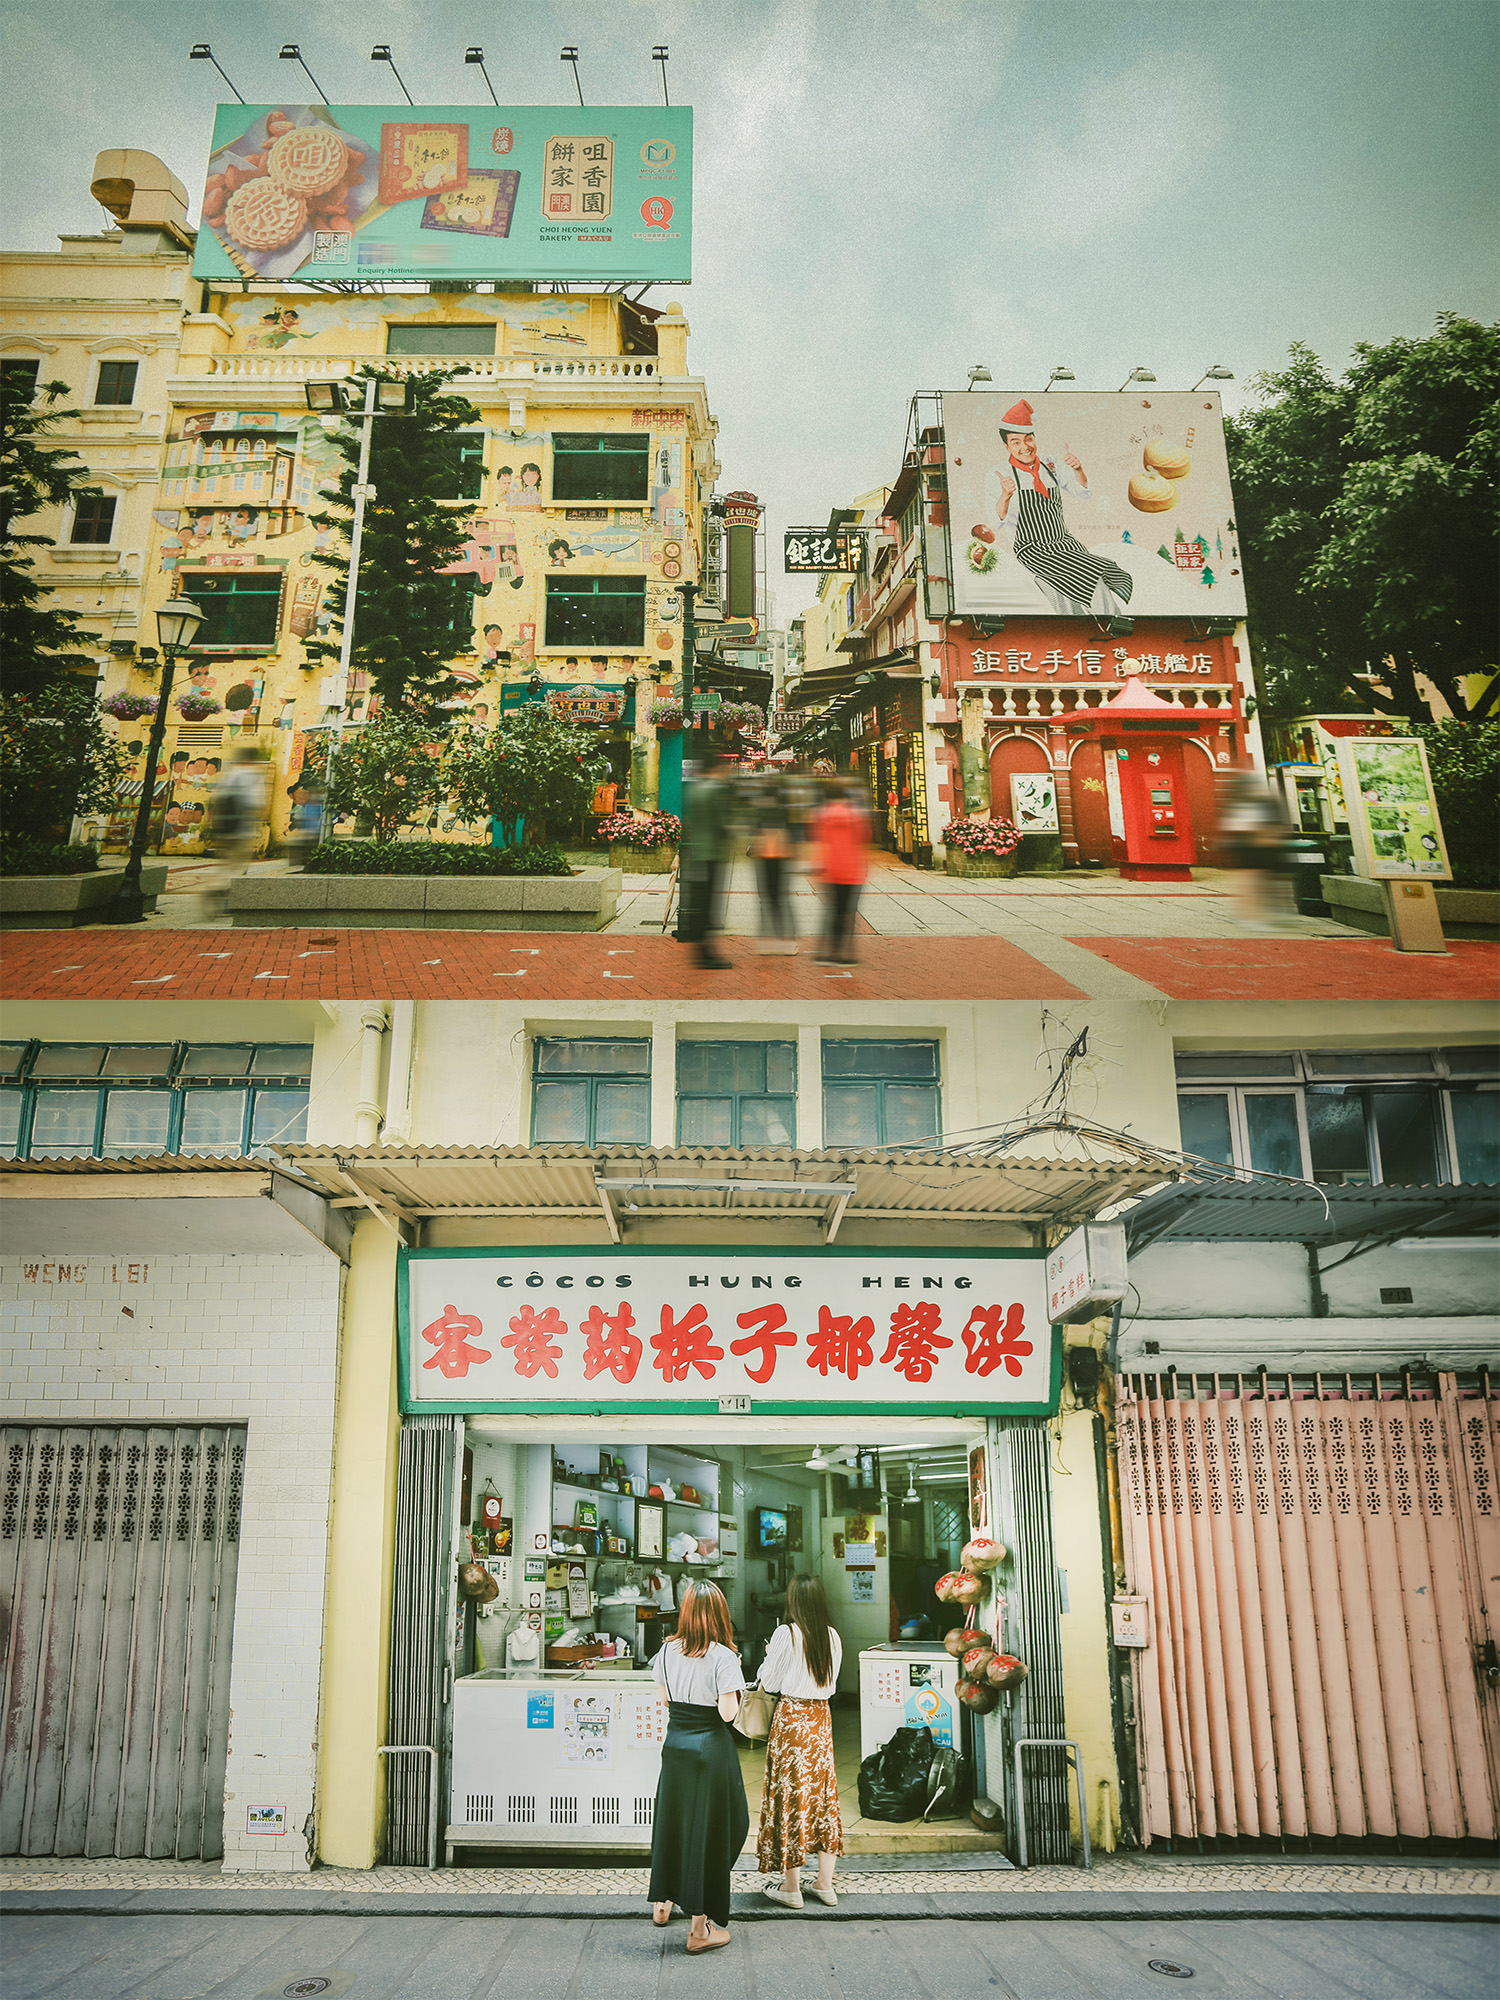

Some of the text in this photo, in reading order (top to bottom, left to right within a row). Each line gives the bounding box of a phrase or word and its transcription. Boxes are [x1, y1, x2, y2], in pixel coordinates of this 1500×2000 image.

[495, 128, 509, 152] 炭燒
[551, 142, 575, 188] 餅家
[582, 142, 608, 214] 咀香園
[650, 206, 665, 215] HK
[357, 267, 386, 275] Enquiry
[632, 408, 685, 428] 新中央
[786, 537, 837, 565] 鉅記
[970, 648, 1106, 675] 鉅記手信
[1139, 652, 1214, 675] 旗艦店
[23, 1263, 149, 1284] WENG LEI
[496, 1270, 973, 1290] CÔCOS HUNG HENG
[1396, 1290, 1408, 1301] 12
[735, 1398, 746, 1409] 14
[850, 1518, 870, 1541] 福
